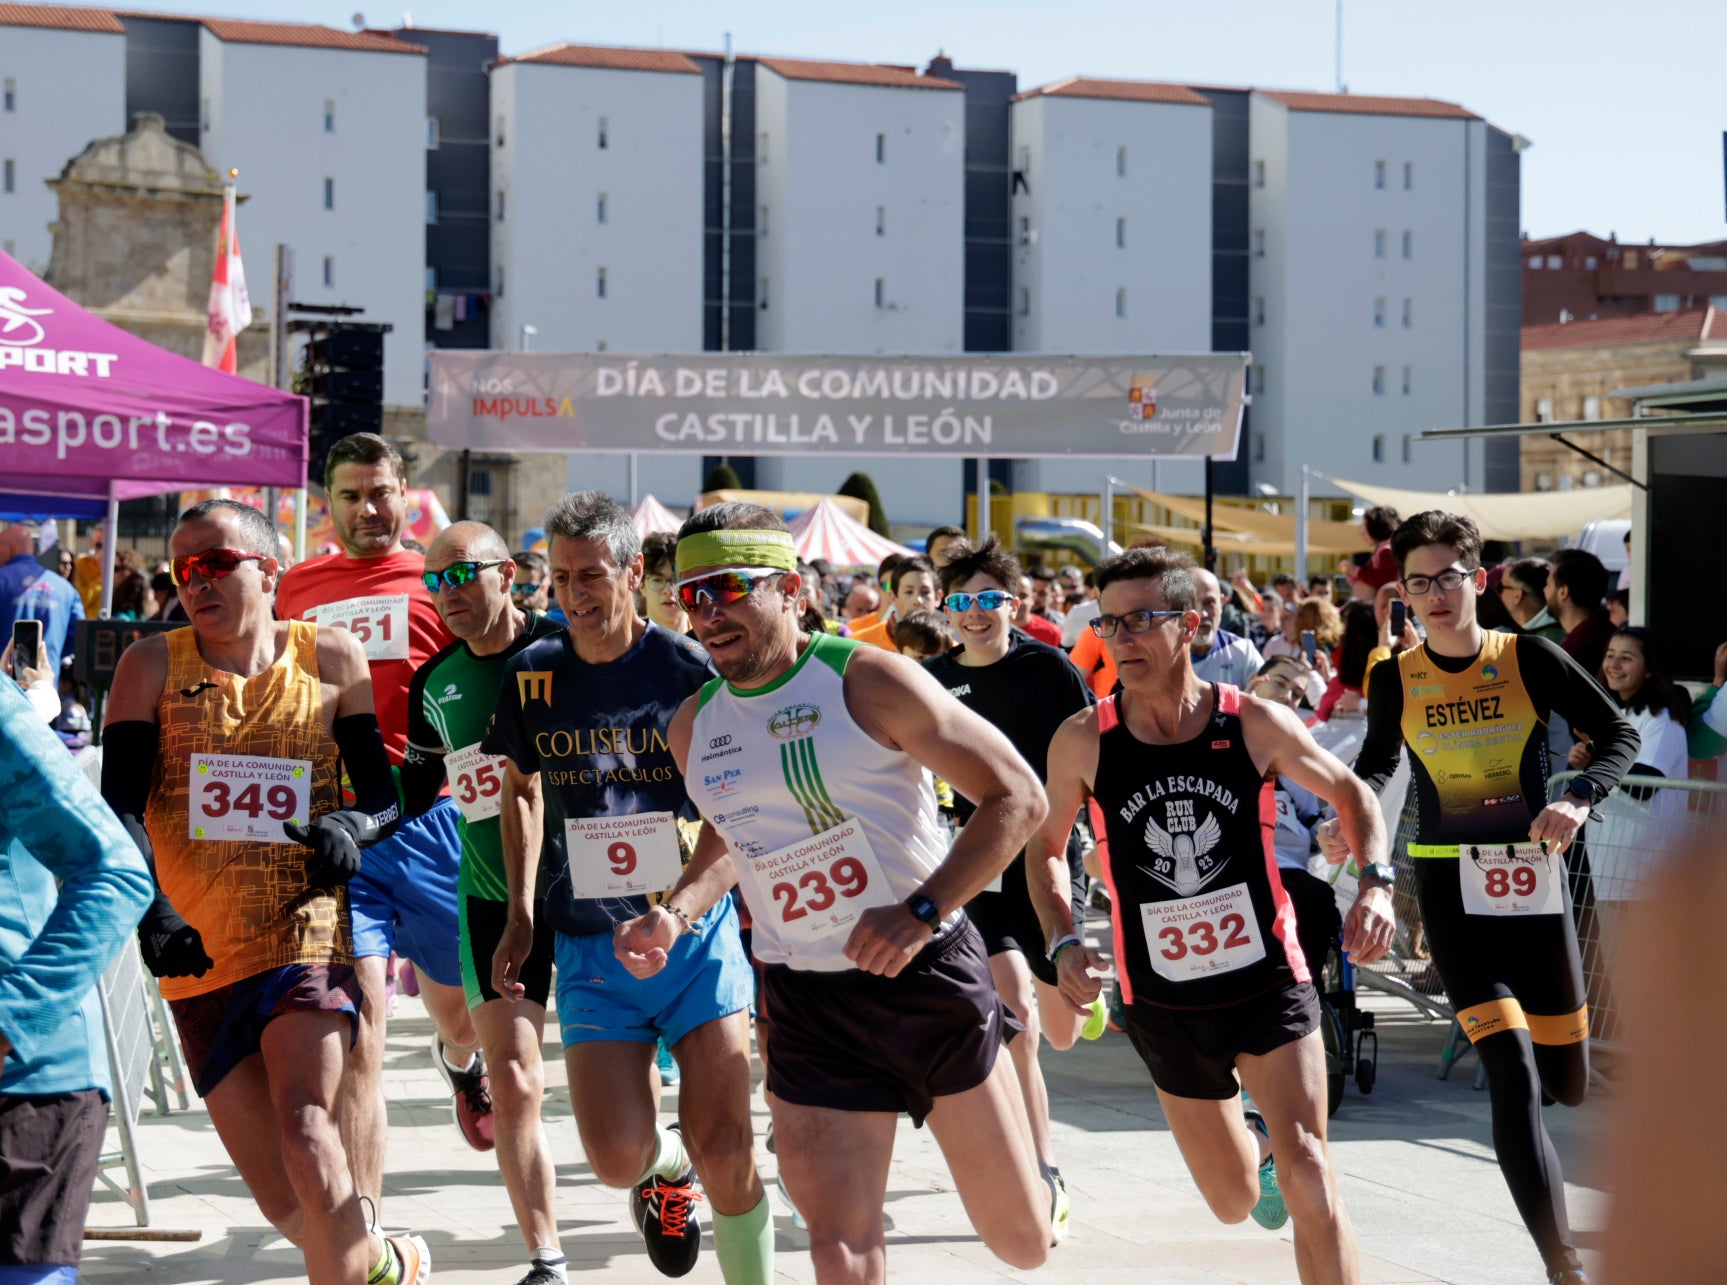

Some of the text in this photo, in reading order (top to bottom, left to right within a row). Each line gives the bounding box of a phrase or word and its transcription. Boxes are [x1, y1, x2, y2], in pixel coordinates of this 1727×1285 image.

[473, 377, 512, 394] NOS
[596, 361, 1059, 400] DÍA DE LA COMUNIDAD
[1159, 406, 1222, 420] Junta de
[655, 407, 993, 444] CASTILLA Y LEÓN
[1119, 420, 1222, 436] Castilla y León
[371, 605, 391, 613] LEÓN
[1425, 695, 1504, 728] ESTÉVEZ
[198, 757, 215, 768] DÍA
[216, 759, 231, 768] DE
[232, 760, 245, 769] LA
[701, 746, 742, 763] Helmántica
[211, 769, 291, 782] CASTILLA Y LEÓN
[548, 766, 672, 785] ESPECTACULOS
[201, 781, 298, 821] 349
[1119, 775, 1239, 824] BAR LA ESCAPADA
[1165, 799, 1194, 817] RUN
[571, 816, 668, 831] DÍA DE LA COMUNIDAD
[1166, 815, 1197, 833] CLUB
[585, 831, 623, 840] CASTILLA
[632, 826, 657, 837] LEÓN
[607, 841, 637, 876] 9
[755, 827, 855, 872] DÍA DE LA COMUNIDAD
[1482, 849, 1492, 857] DE
[1522, 854, 1542, 863] LEÓN
[769, 844, 845, 880] CASTILLA Y LEÓN
[1153, 855, 1214, 873] 20 23
[772, 856, 868, 923] 239
[1484, 866, 1537, 898] 89
[1147, 889, 1243, 916] DÍA DE LA COMUNIDAD
[1161, 902, 1233, 924] CASTILLA Y LEÓN
[1158, 912, 1251, 961] 332
